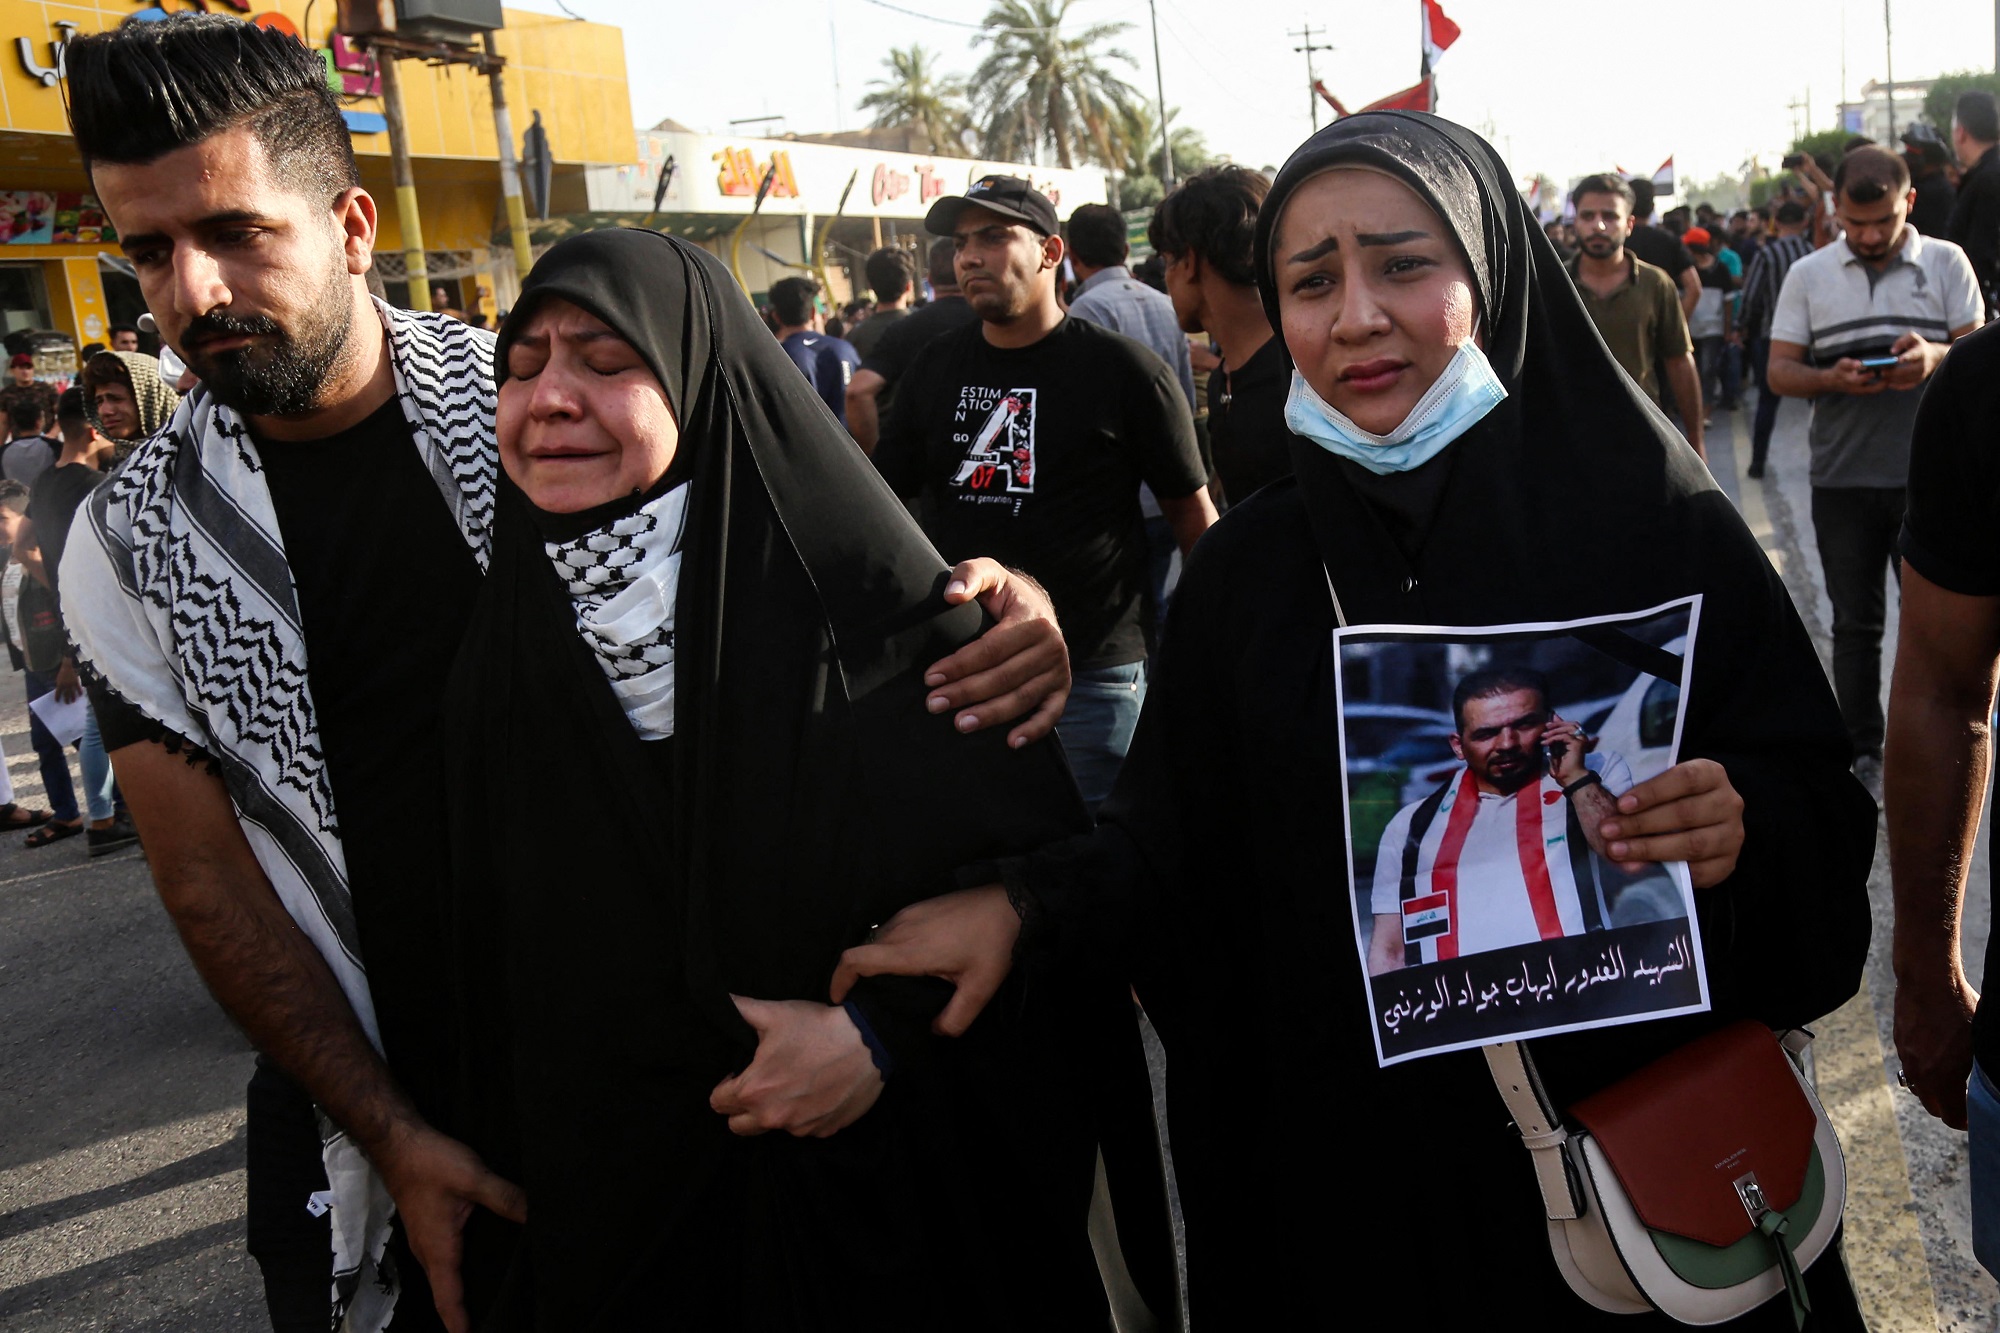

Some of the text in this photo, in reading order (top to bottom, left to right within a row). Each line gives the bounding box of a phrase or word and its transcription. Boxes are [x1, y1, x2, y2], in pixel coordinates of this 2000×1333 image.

[957, 399, 993, 411] ATIO
[960, 386, 1002, 399] ESTIM
[956, 411, 966, 422] N
[953, 433, 969, 442] GO
[1565, 944, 1626, 994] المغدور
[1633, 934, 1691, 986] الشهيد
[1458, 970, 1500, 1013] جواد
[1505, 955, 1558, 1005] ايهاب
